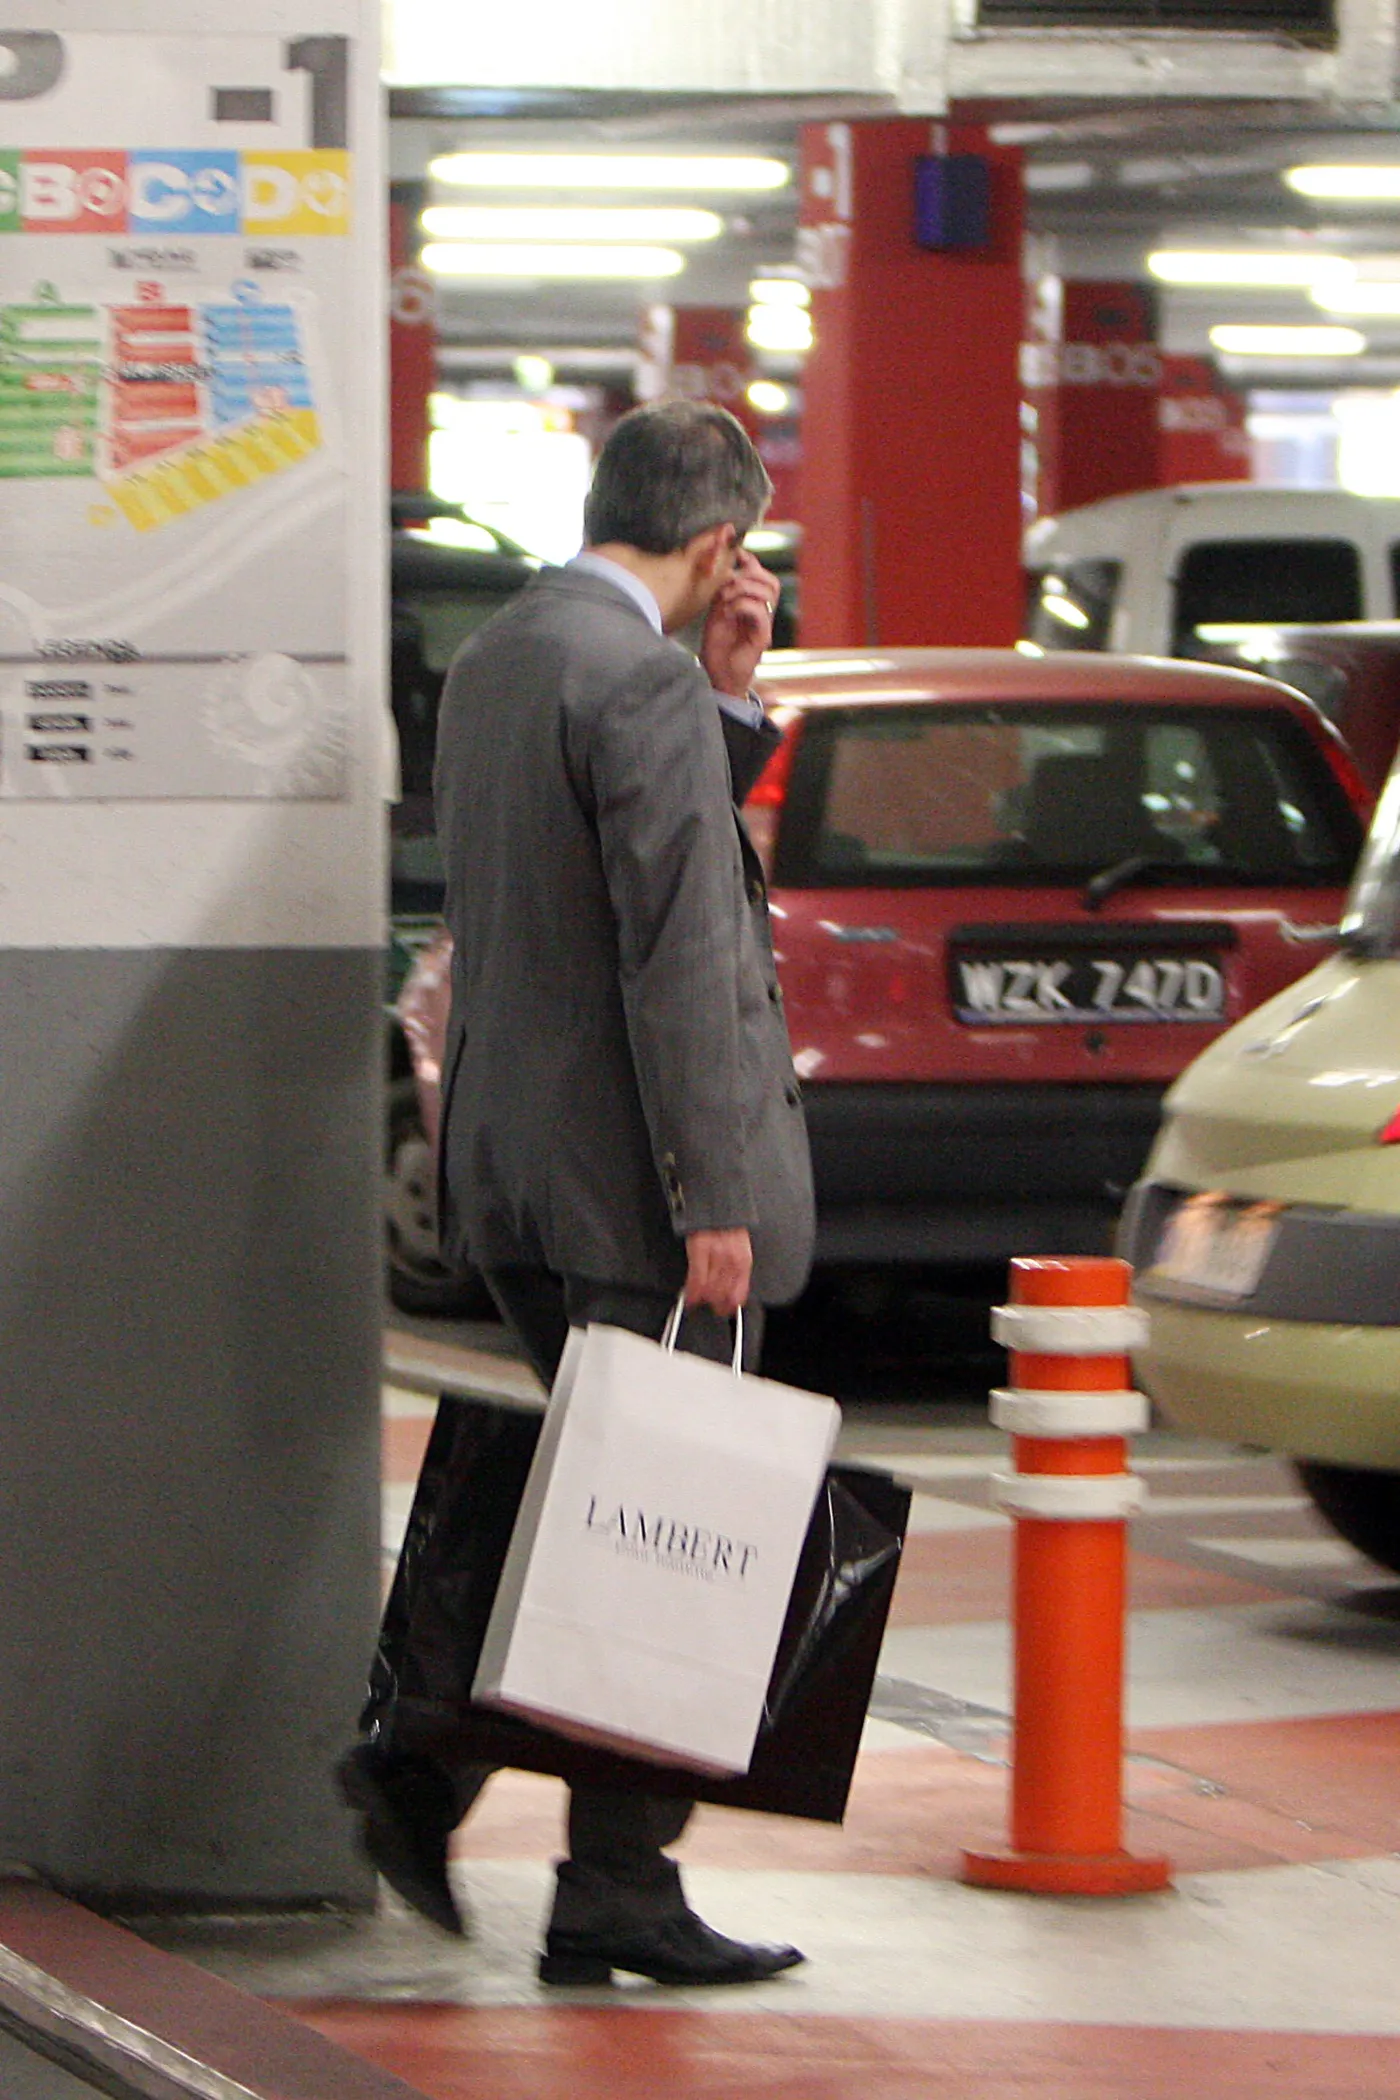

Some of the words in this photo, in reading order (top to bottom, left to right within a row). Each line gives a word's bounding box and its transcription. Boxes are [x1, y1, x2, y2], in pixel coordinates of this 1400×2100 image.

[208, 34, 349, 150] -1
[243, 165, 300, 219] D
[958, 960, 1073, 1012] WZK
[586, 1494, 758, 1579] LAMBERT
